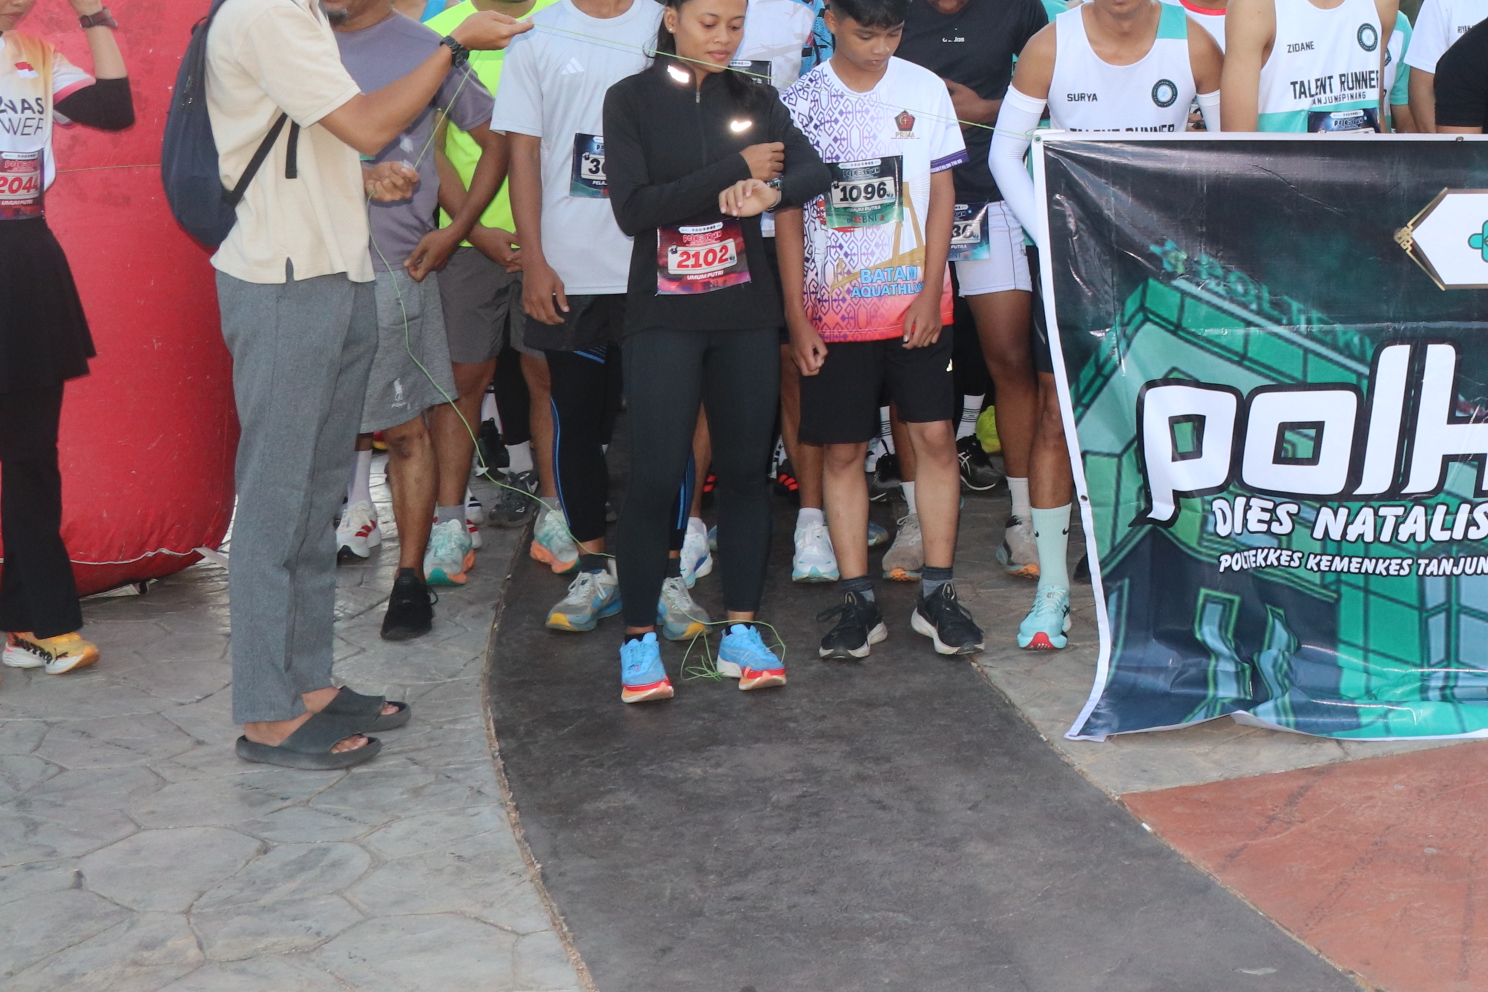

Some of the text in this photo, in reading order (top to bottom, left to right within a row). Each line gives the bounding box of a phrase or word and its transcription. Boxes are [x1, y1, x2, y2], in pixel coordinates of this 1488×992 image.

[1287, 40, 1315, 54] ZIDANE
[1066, 93, 1098, 102] SURYA
[1290, 75, 1334, 100] TALENT
[840, 181, 887, 203] 1096
[677, 244, 729, 269] 2102
[860, 265, 918, 284] BATAM
[1213, 496, 1299, 537] DIES
[1219, 548, 1303, 572] POLTEKKES
[1306, 554, 1412, 576] KEMENKES
